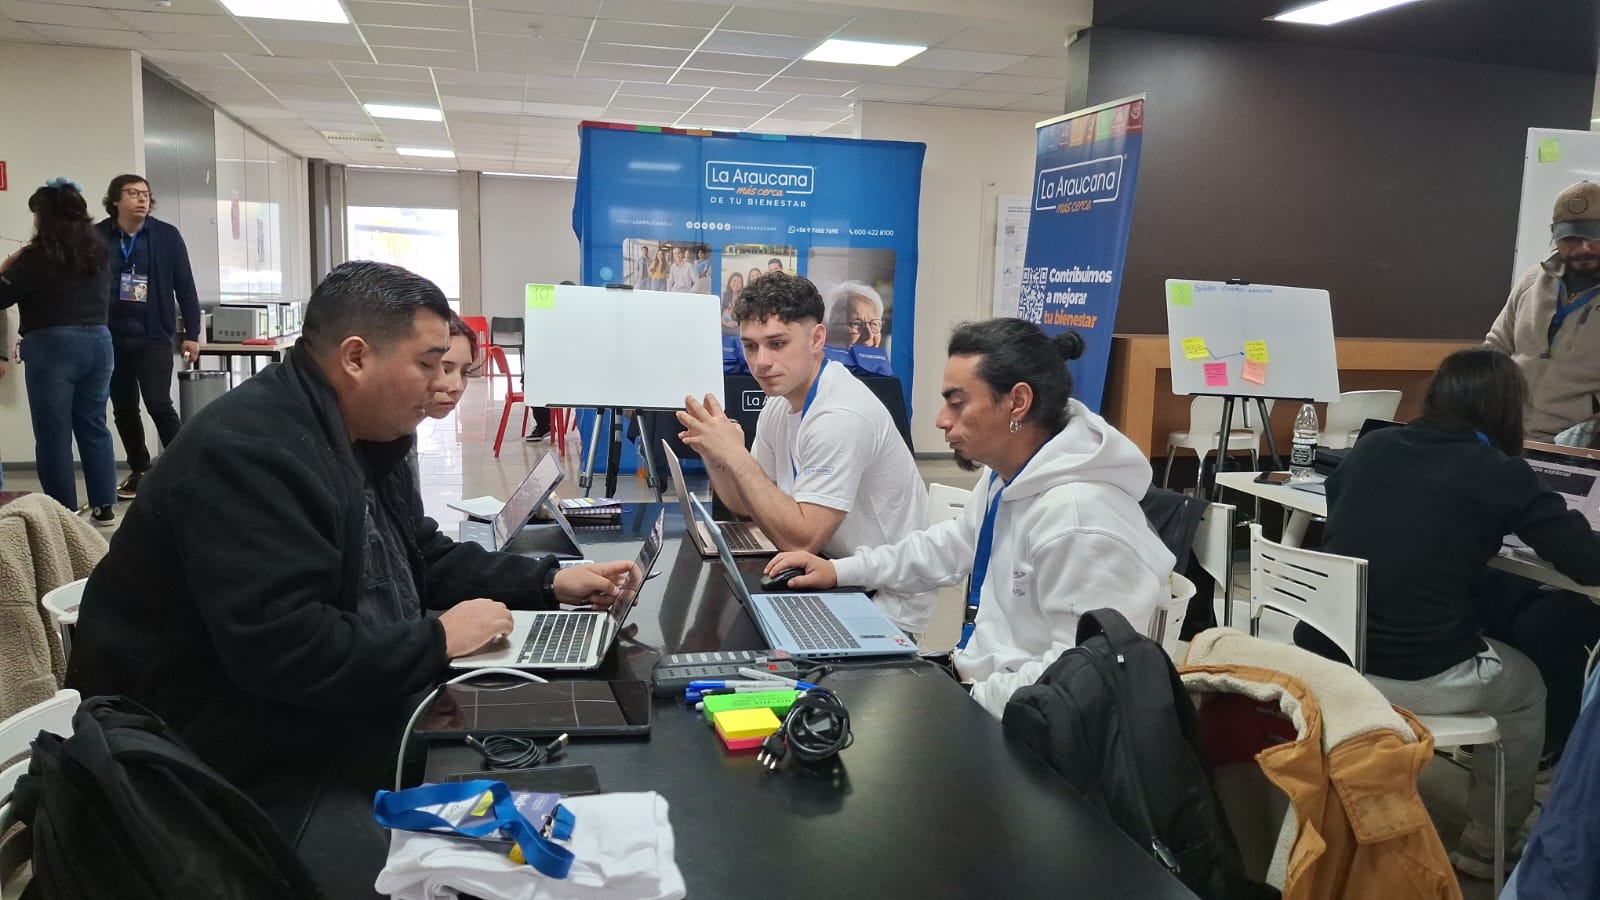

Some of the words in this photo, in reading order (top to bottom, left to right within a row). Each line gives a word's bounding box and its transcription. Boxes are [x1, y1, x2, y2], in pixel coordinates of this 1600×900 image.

[712, 167, 729, 183] La
[732, 168, 808, 187] Araucana
[1040, 179, 1055, 200] La
[1055, 171, 1116, 198] Araucana
[736, 185, 757, 196] más
[757, 188, 784, 197] cerca
[710, 196, 724, 204] DE
[729, 197, 742, 205] TU
[747, 198, 807, 208] BIENESTAR
[1049, 265, 1113, 283] Contribuimos
[1046, 292, 1051, 304] a
[1053, 287, 1087, 308] mejorar
[1044, 310, 1053, 325] tu
[1054, 309, 1098, 328] bienestar
[746, 395, 760, 406] La
